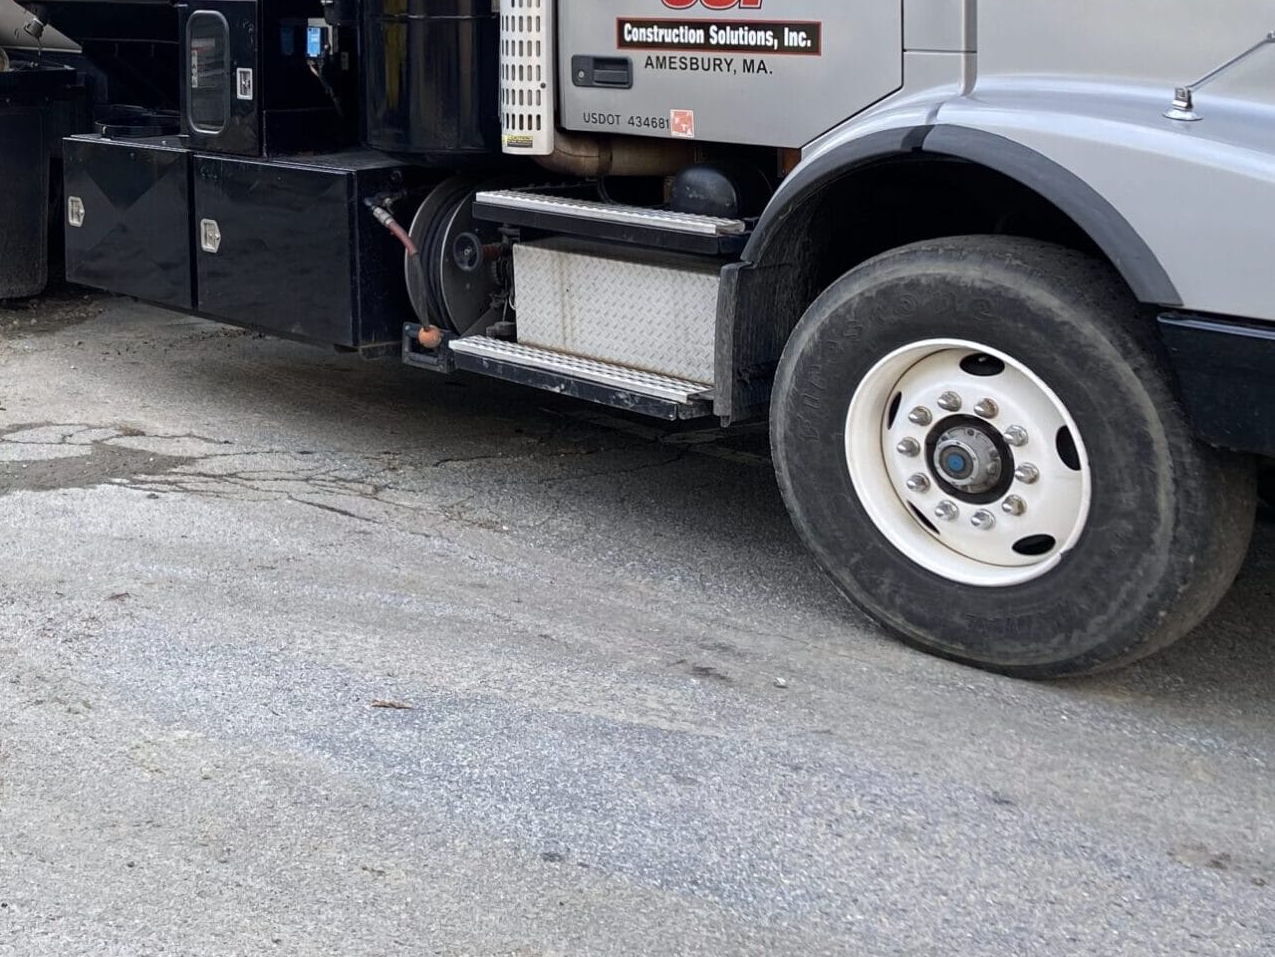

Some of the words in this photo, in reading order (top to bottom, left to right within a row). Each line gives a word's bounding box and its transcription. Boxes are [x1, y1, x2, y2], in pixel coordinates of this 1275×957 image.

[623, 23, 705, 44] Construction
[709, 25, 778, 50] Solutions,
[783, 27, 812, 48] Inc.
[644, 55, 737, 75] AMESBURY,
[742, 59, 774, 75] MA.
[583, 112, 621, 125] USDOT
